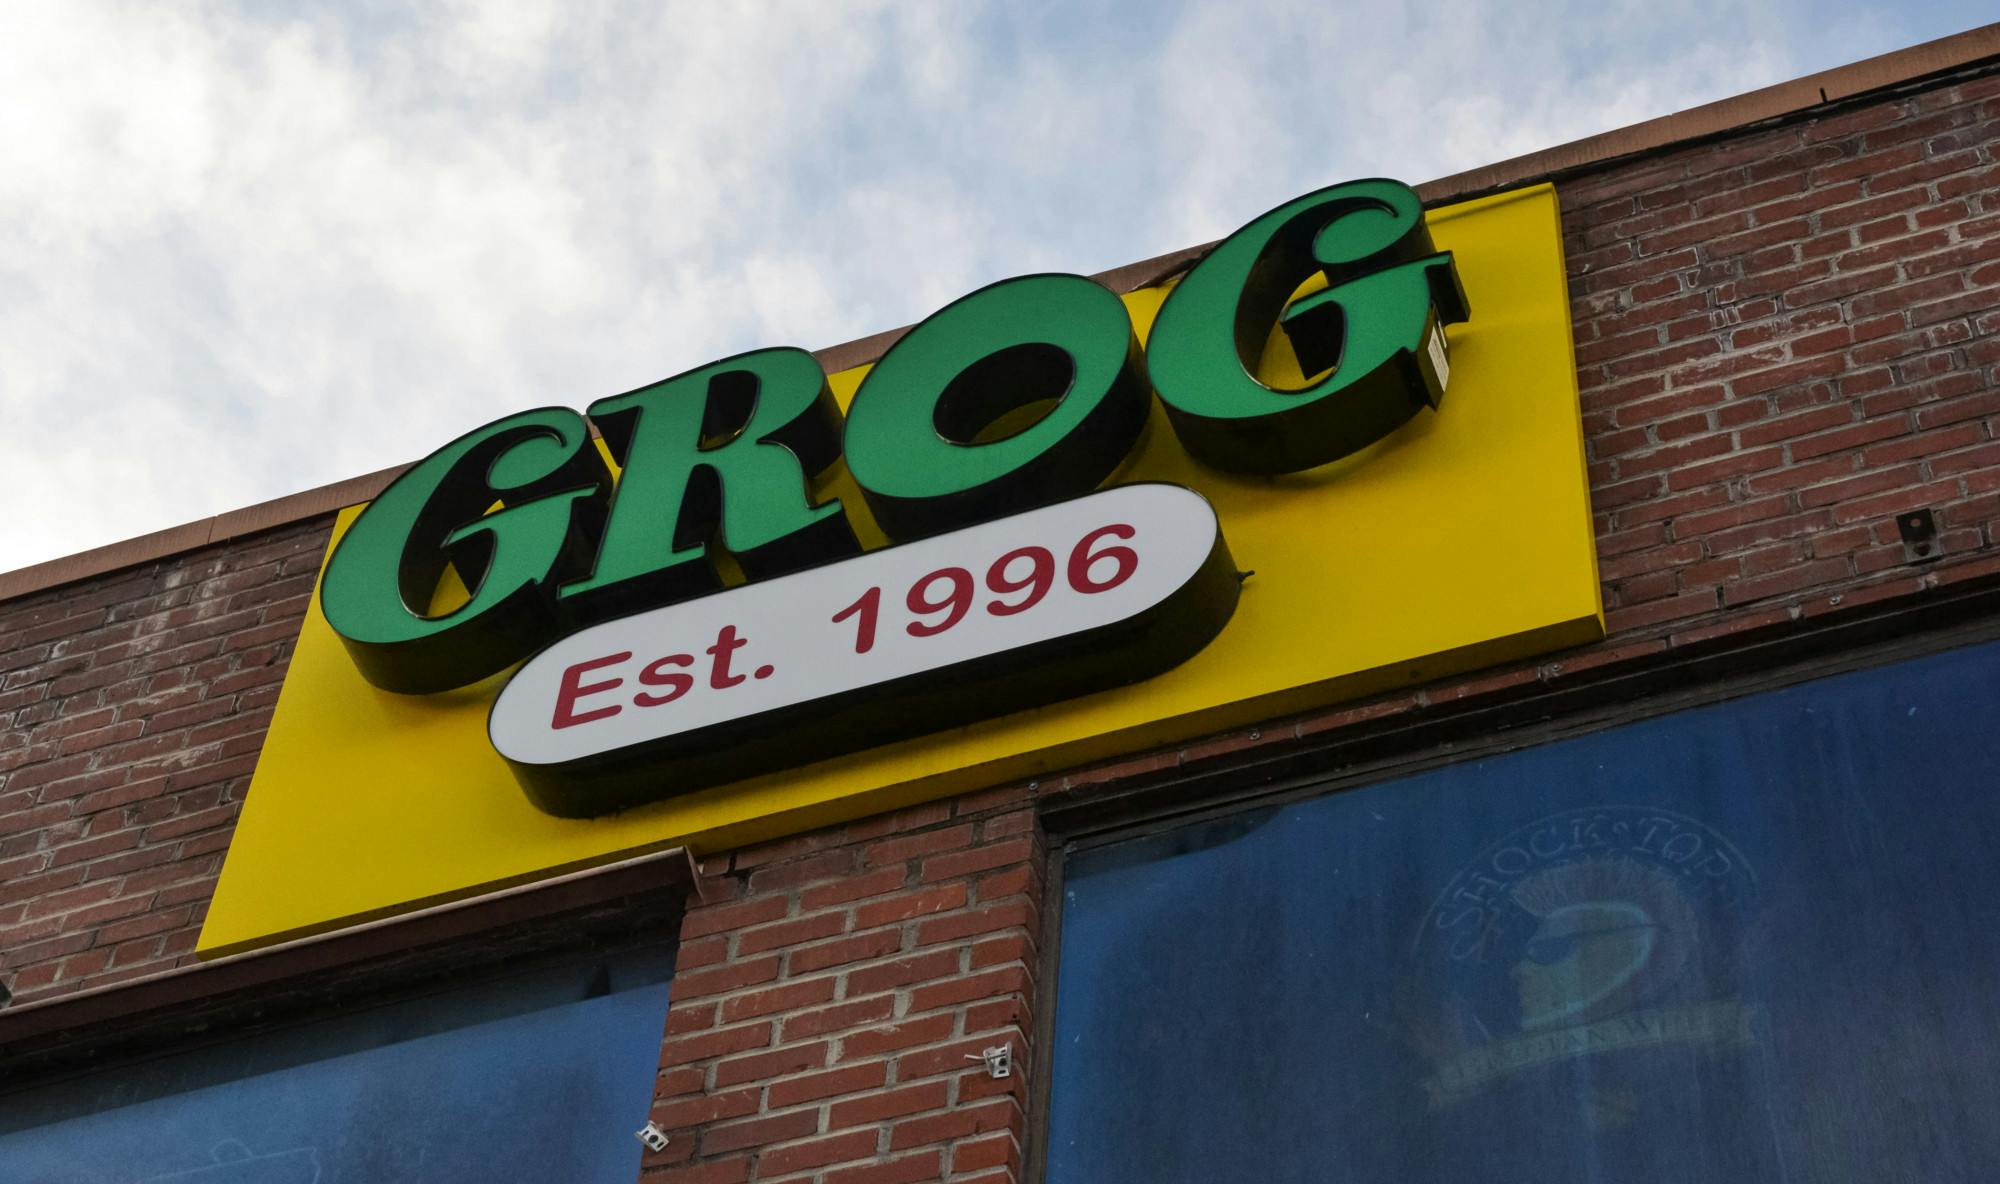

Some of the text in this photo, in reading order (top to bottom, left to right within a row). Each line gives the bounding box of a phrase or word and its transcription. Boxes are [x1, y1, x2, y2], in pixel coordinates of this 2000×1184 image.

[320, 178, 1454, 644] GROG
[551, 523, 1139, 730] Est. 1996
